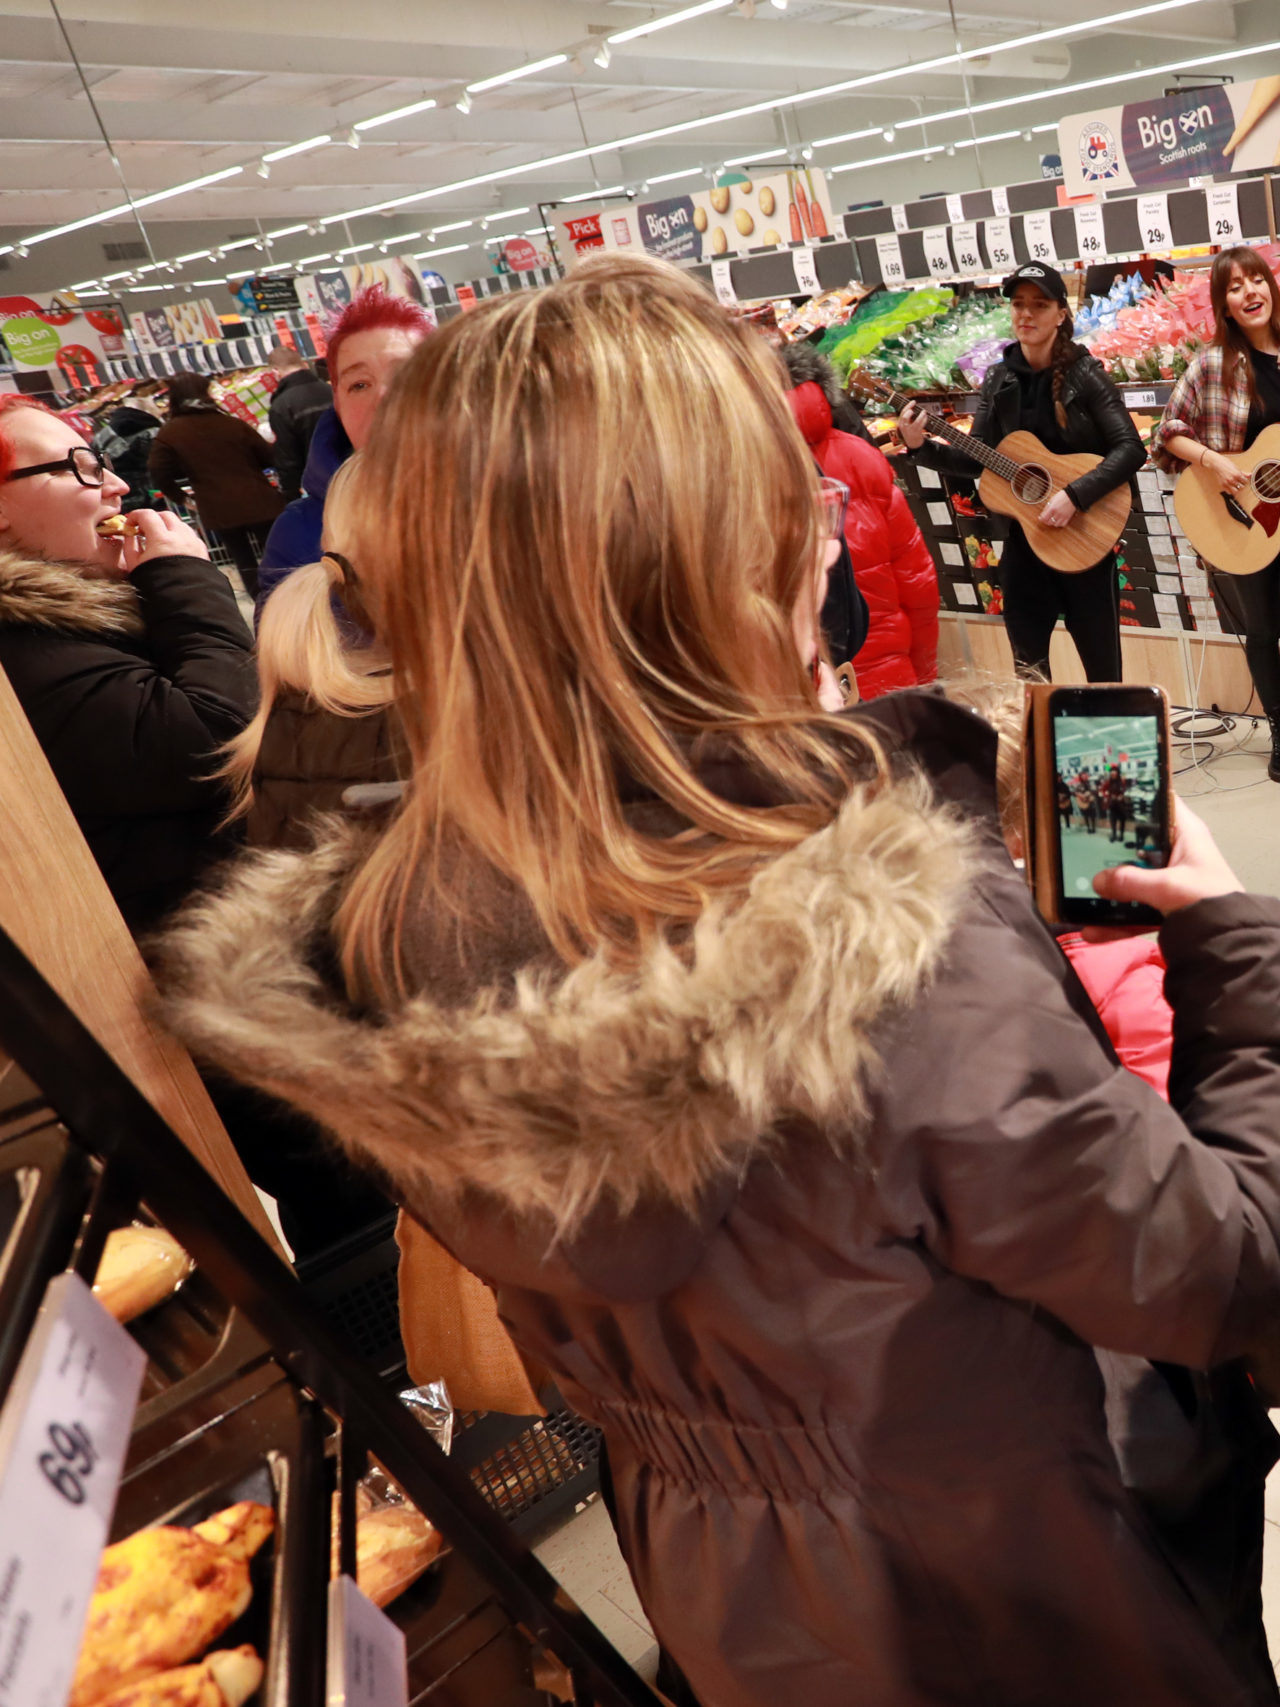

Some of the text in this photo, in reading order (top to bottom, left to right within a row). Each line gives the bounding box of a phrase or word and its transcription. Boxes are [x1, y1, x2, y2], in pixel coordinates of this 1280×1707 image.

[1138, 115, 1178, 150] Big
[1159, 141, 1207, 165] Scottish roots
[1042, 165, 1056, 179] Big
[572, 219, 598, 237] Pick
[646, 213, 671, 240] Big
[1216, 219, 1234, 236] 29p
[1083, 236, 1101, 251] 48p
[1147, 228, 1165, 244] 29p
[994, 248, 1009, 264] 55p
[1033, 243, 1049, 258] 35p
[932, 257, 948, 271] 48p
[961, 252, 977, 268] 48p
[885, 262, 901, 276] 1.69
[4, 328, 51, 346] Big on
